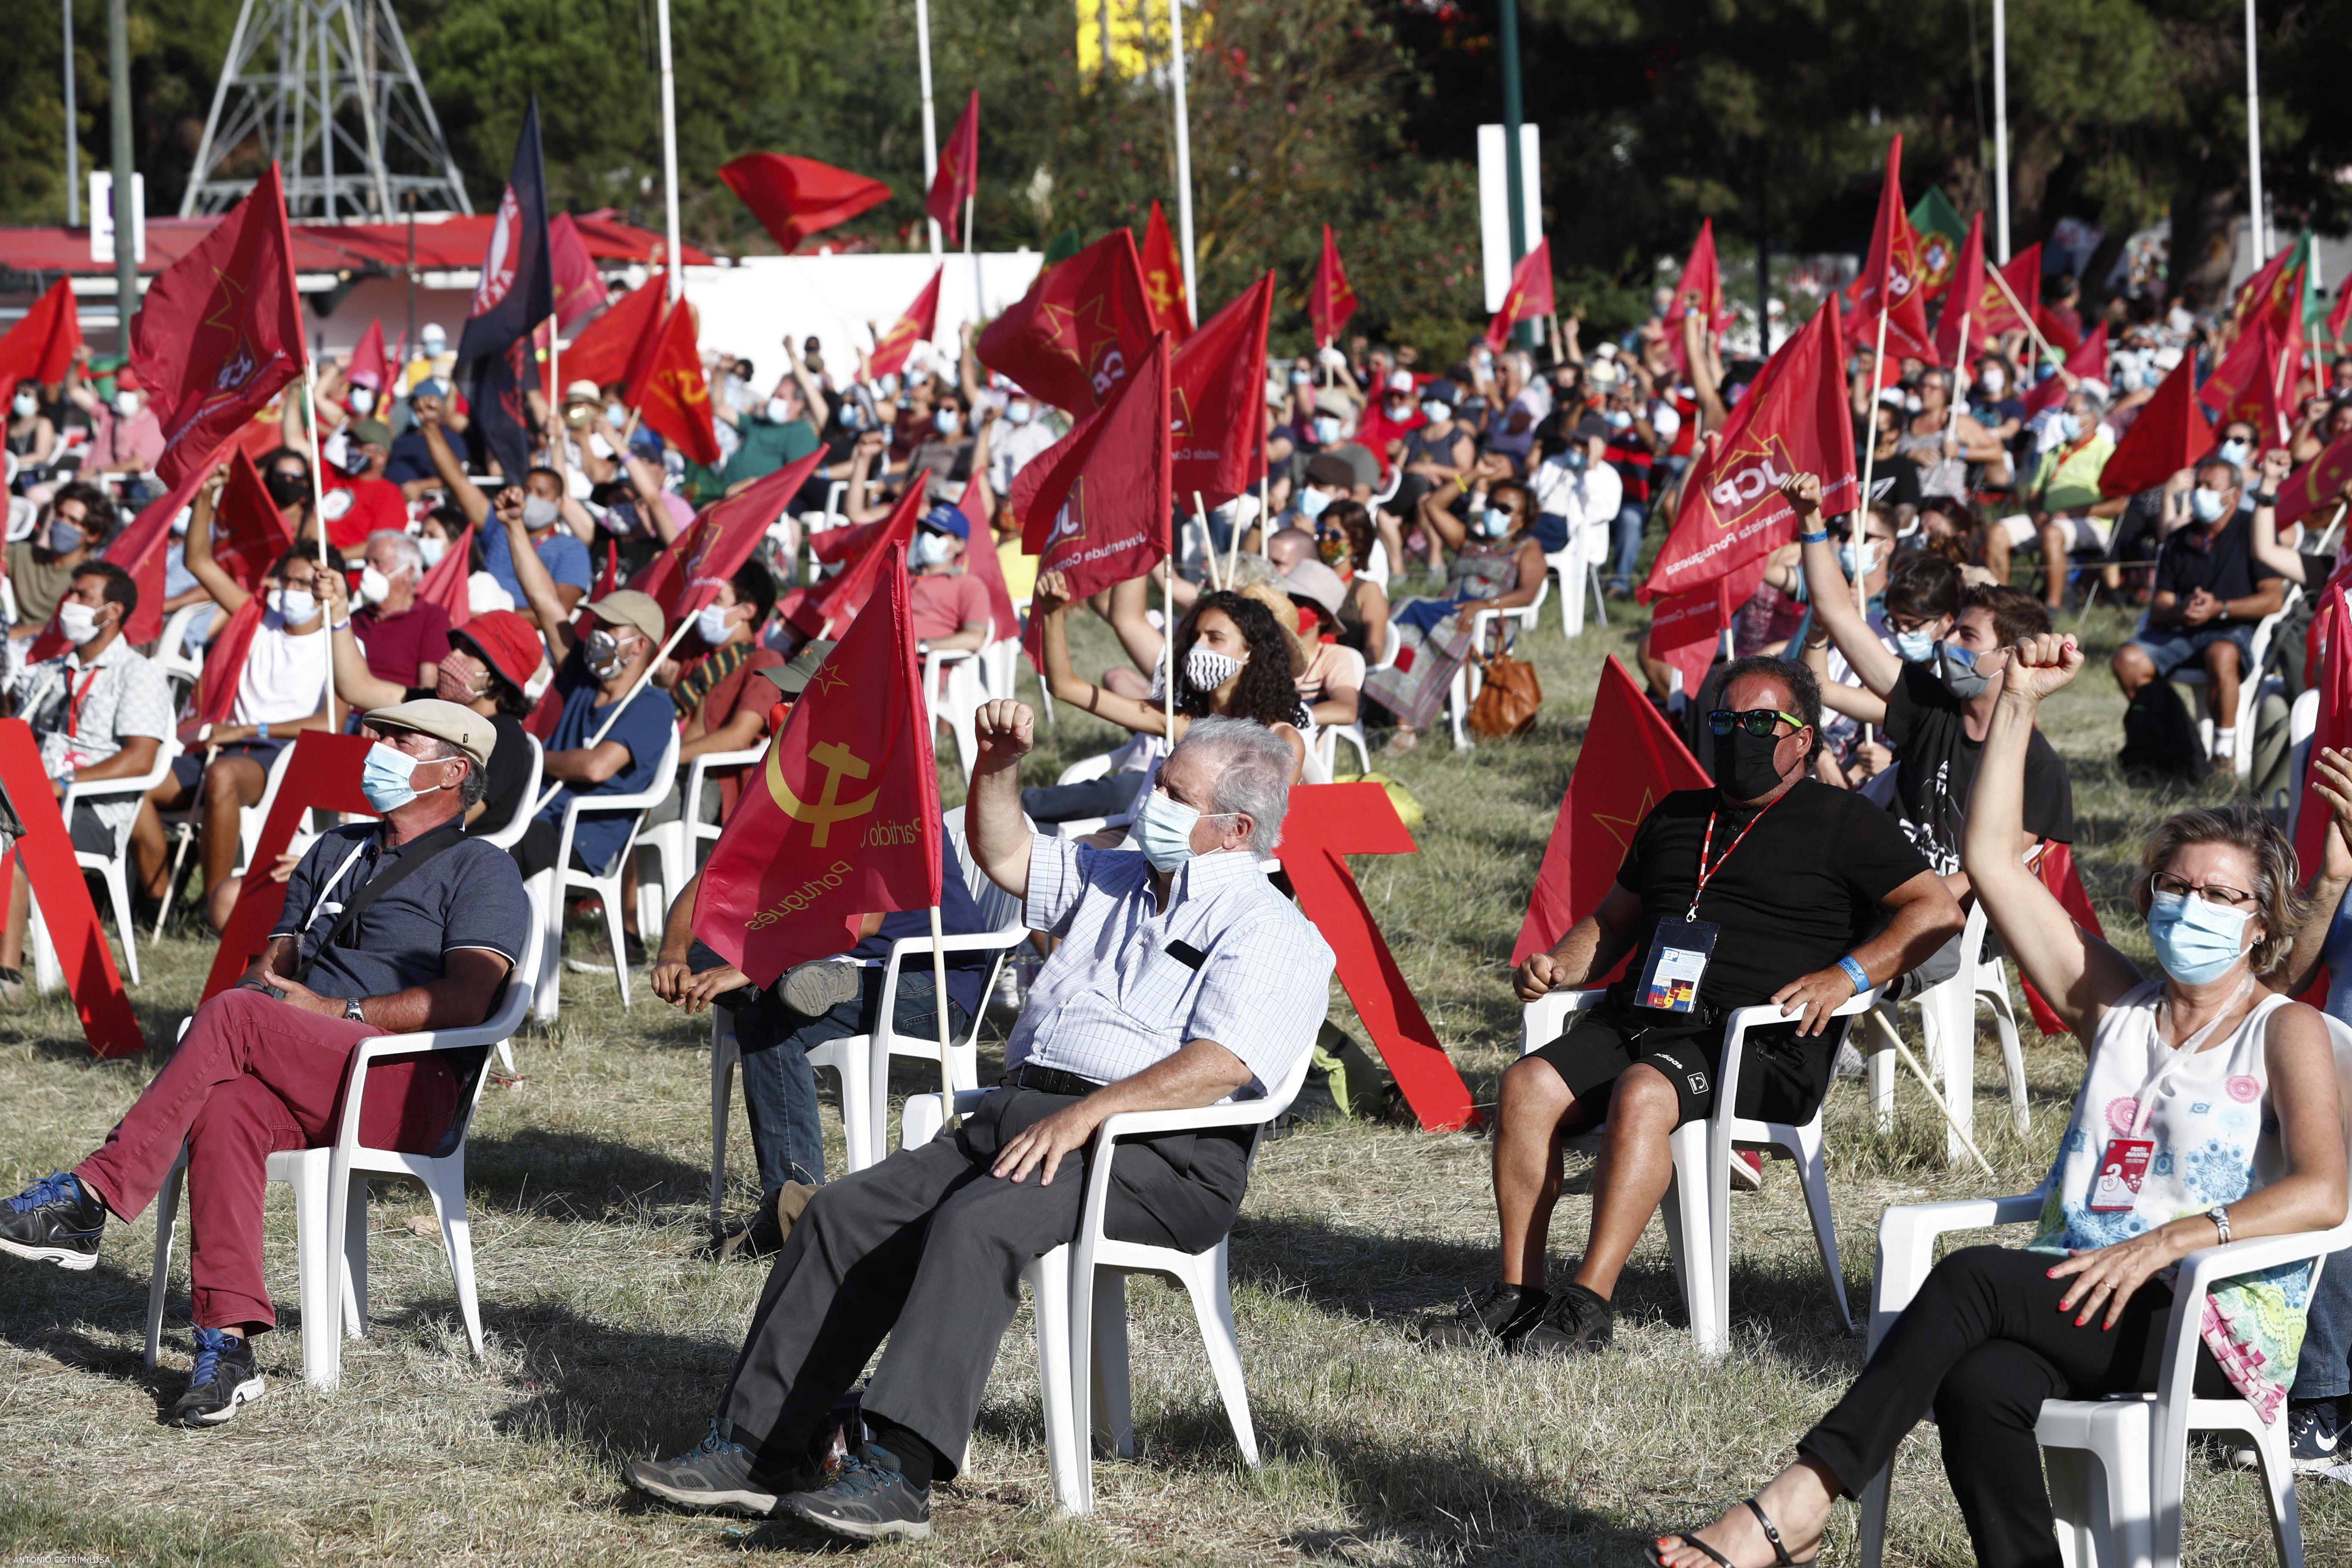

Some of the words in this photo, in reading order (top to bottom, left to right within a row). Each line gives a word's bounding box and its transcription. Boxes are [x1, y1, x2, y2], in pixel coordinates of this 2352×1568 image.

[1663, 949, 1679, 961] EP
[1654, 1053, 1683, 1069] adidas
[2101, 1163, 2122, 1192] 3
